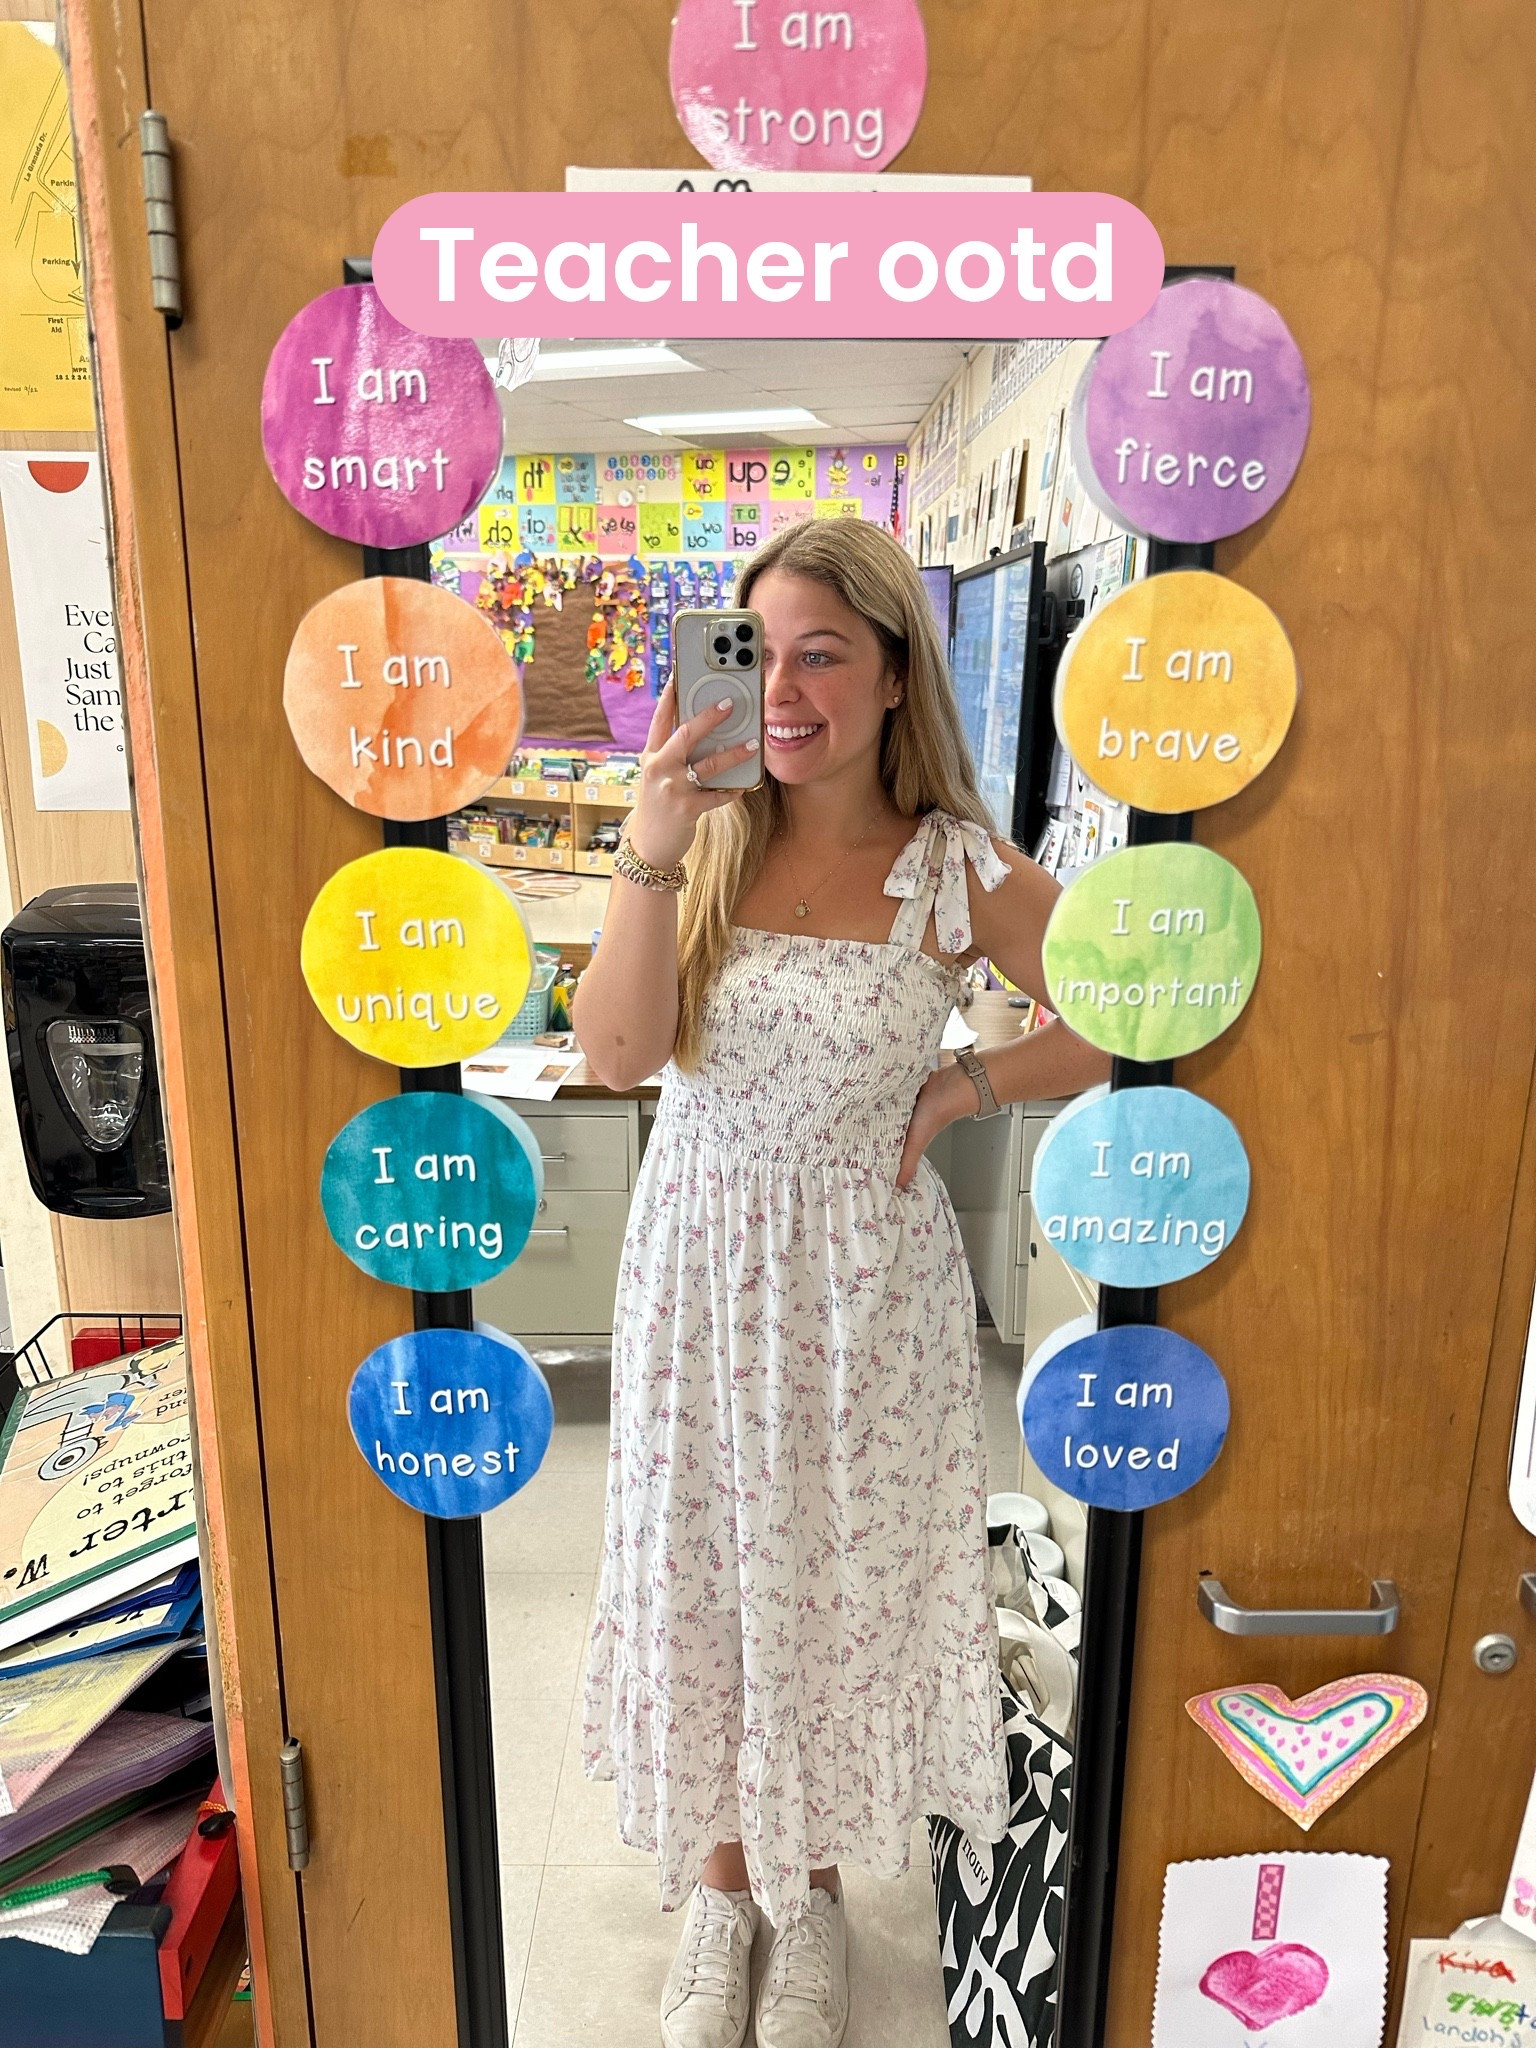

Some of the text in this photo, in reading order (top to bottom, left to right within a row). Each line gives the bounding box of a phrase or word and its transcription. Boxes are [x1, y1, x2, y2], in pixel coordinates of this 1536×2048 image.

[734, 0, 851, 48] I am
[707, 98, 884, 160] strong
[42, 258, 71, 267] Parking
[47, 316, 64, 325] First
[312, 358, 426, 404] I am
[1148, 351, 1251, 402] I am
[304, 448, 448, 490] smart
[1115, 438, 1265, 490] fierce
[65, 657, 112, 682] Just
[338, 645, 449, 687] I am
[1123, 637, 1230, 681] I am
[74, 707, 114, 731] the
[1099, 718, 1240, 761] brave
[351, 727, 452, 767] kind
[356, 911, 463, 949] I am
[1112, 899, 1203, 934] I am
[337, 988, 501, 1031] unique
[1056, 977, 1241, 1011] important
[372, 1148, 475, 1183] I am
[1091, 1141, 1189, 1177] I am
[355, 1217, 504, 1261] caring
[1043, 1215, 1226, 1258] amazing
[391, 1381, 488, 1414] I am
[1077, 1374, 1172, 1408] I am
[98, 1450, 188, 1494] this to
[376, 1441, 519, 1477] honest
[1065, 1436, 1179, 1470] loved
[76, 1463, 193, 1520] forget to
